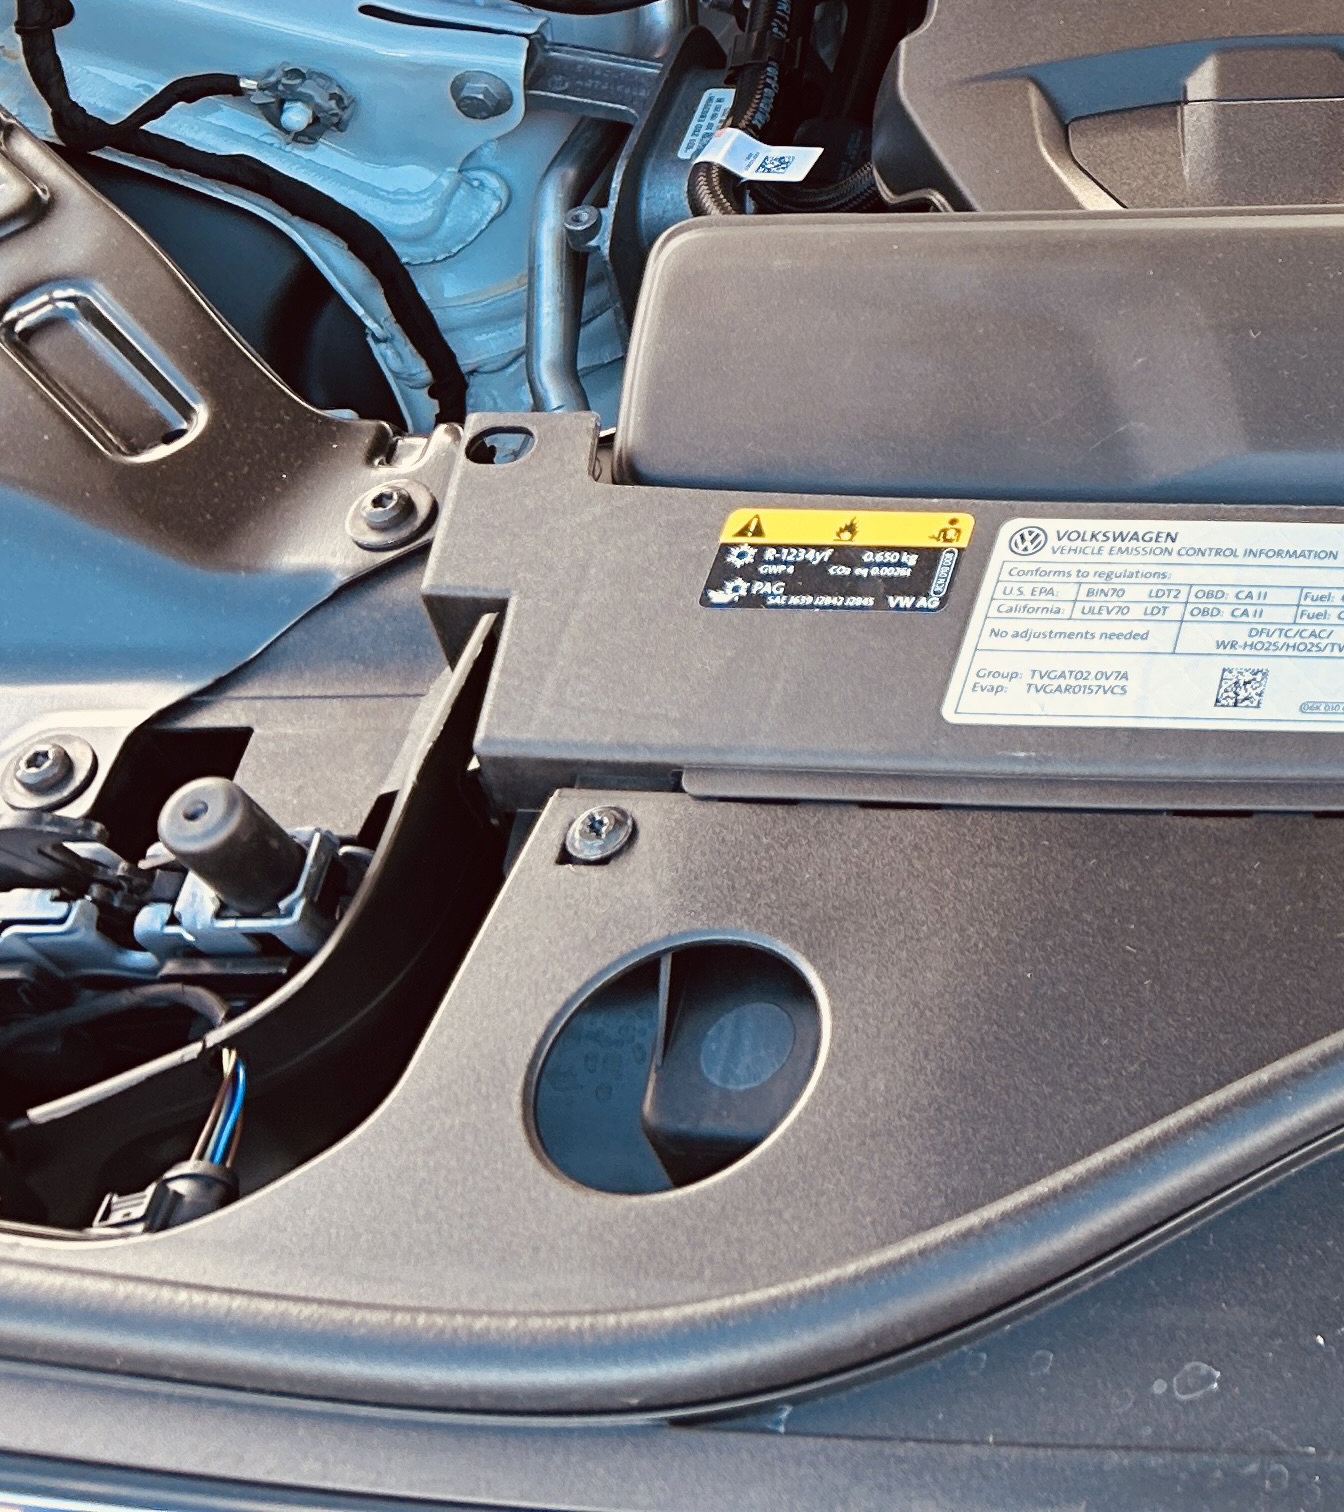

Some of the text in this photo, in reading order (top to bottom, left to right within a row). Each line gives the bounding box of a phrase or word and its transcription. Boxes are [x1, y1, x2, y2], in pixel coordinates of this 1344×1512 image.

[1057, 530, 1178, 543] VOLKSWAGEN
[764, 547, 919, 566] R-1234yf 0.650 kg
[1052, 546, 1338, 560] VEHICLE EMISSION CONTROL INFORMATION
[1008, 567, 1072, 578] Conforms
[1076, 569, 1089, 578] to
[751, 581, 785, 595] PAG
[1086, 588, 1181, 599] BIN70 LDT2
[1235, 591, 1253, 600] CA
[887, 596, 940, 609] VW AG
[1081, 606, 1169, 616] ULEV70 LDT
[1231, 608, 1249, 617] CA
[989, 628, 1150, 642] No adjustments needed
[1248, 628, 1334, 639] DFI/TC/CAC/
[976, 668, 1022, 681] Group:
[972, 682, 1007, 695] Evap:
